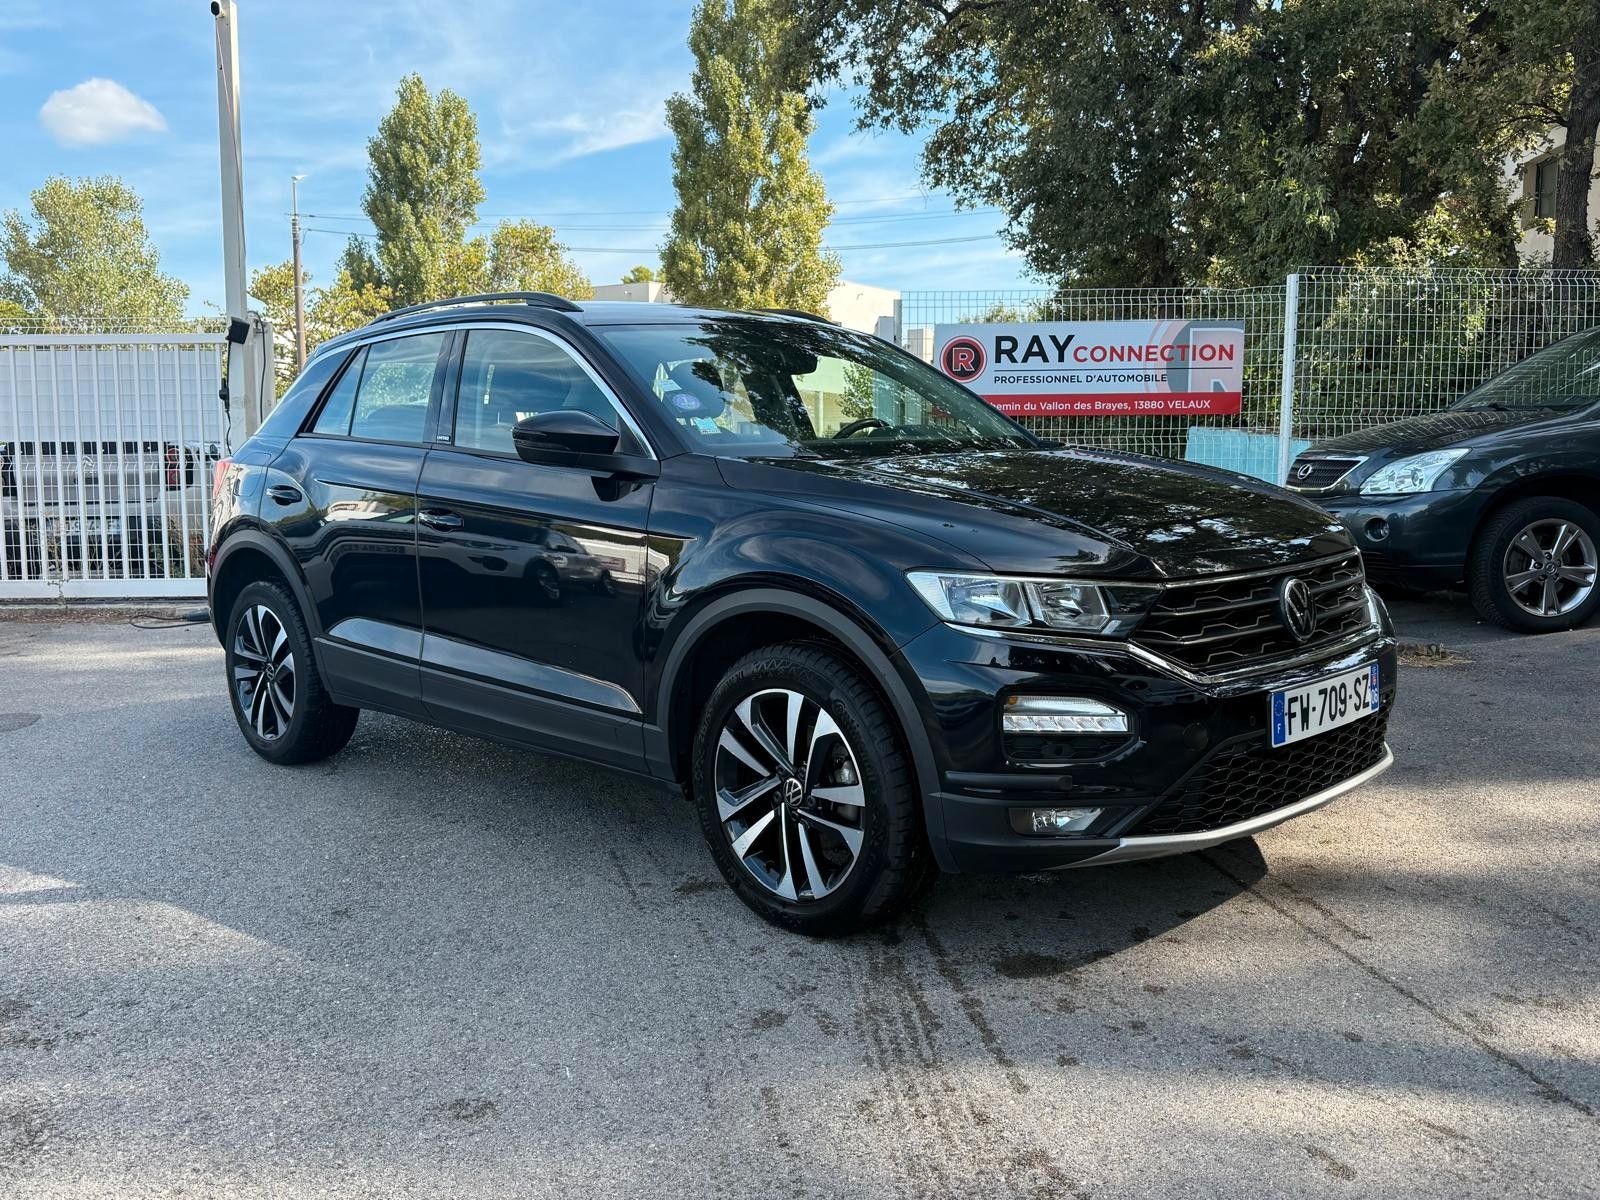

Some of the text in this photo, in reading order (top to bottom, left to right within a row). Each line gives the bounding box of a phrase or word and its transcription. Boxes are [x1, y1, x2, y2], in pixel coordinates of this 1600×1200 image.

[952, 347, 975, 371] R
[994, 334, 1234, 364] RAY CONNECTION
[994, 373, 1168, 384] PROFESSIONNEL D'AUTOMOBILE
[1023, 401, 1037, 411] du
[1039, 401, 1071, 411] Vallon
[1073, 401, 1092, 410] des
[1094, 401, 1131, 411] Brayes,
[1134, 400, 1164, 410] 13880
[1167, 399, 1211, 409] VELAUX
[1287, 673, 1370, 736] FW-709-SZ
